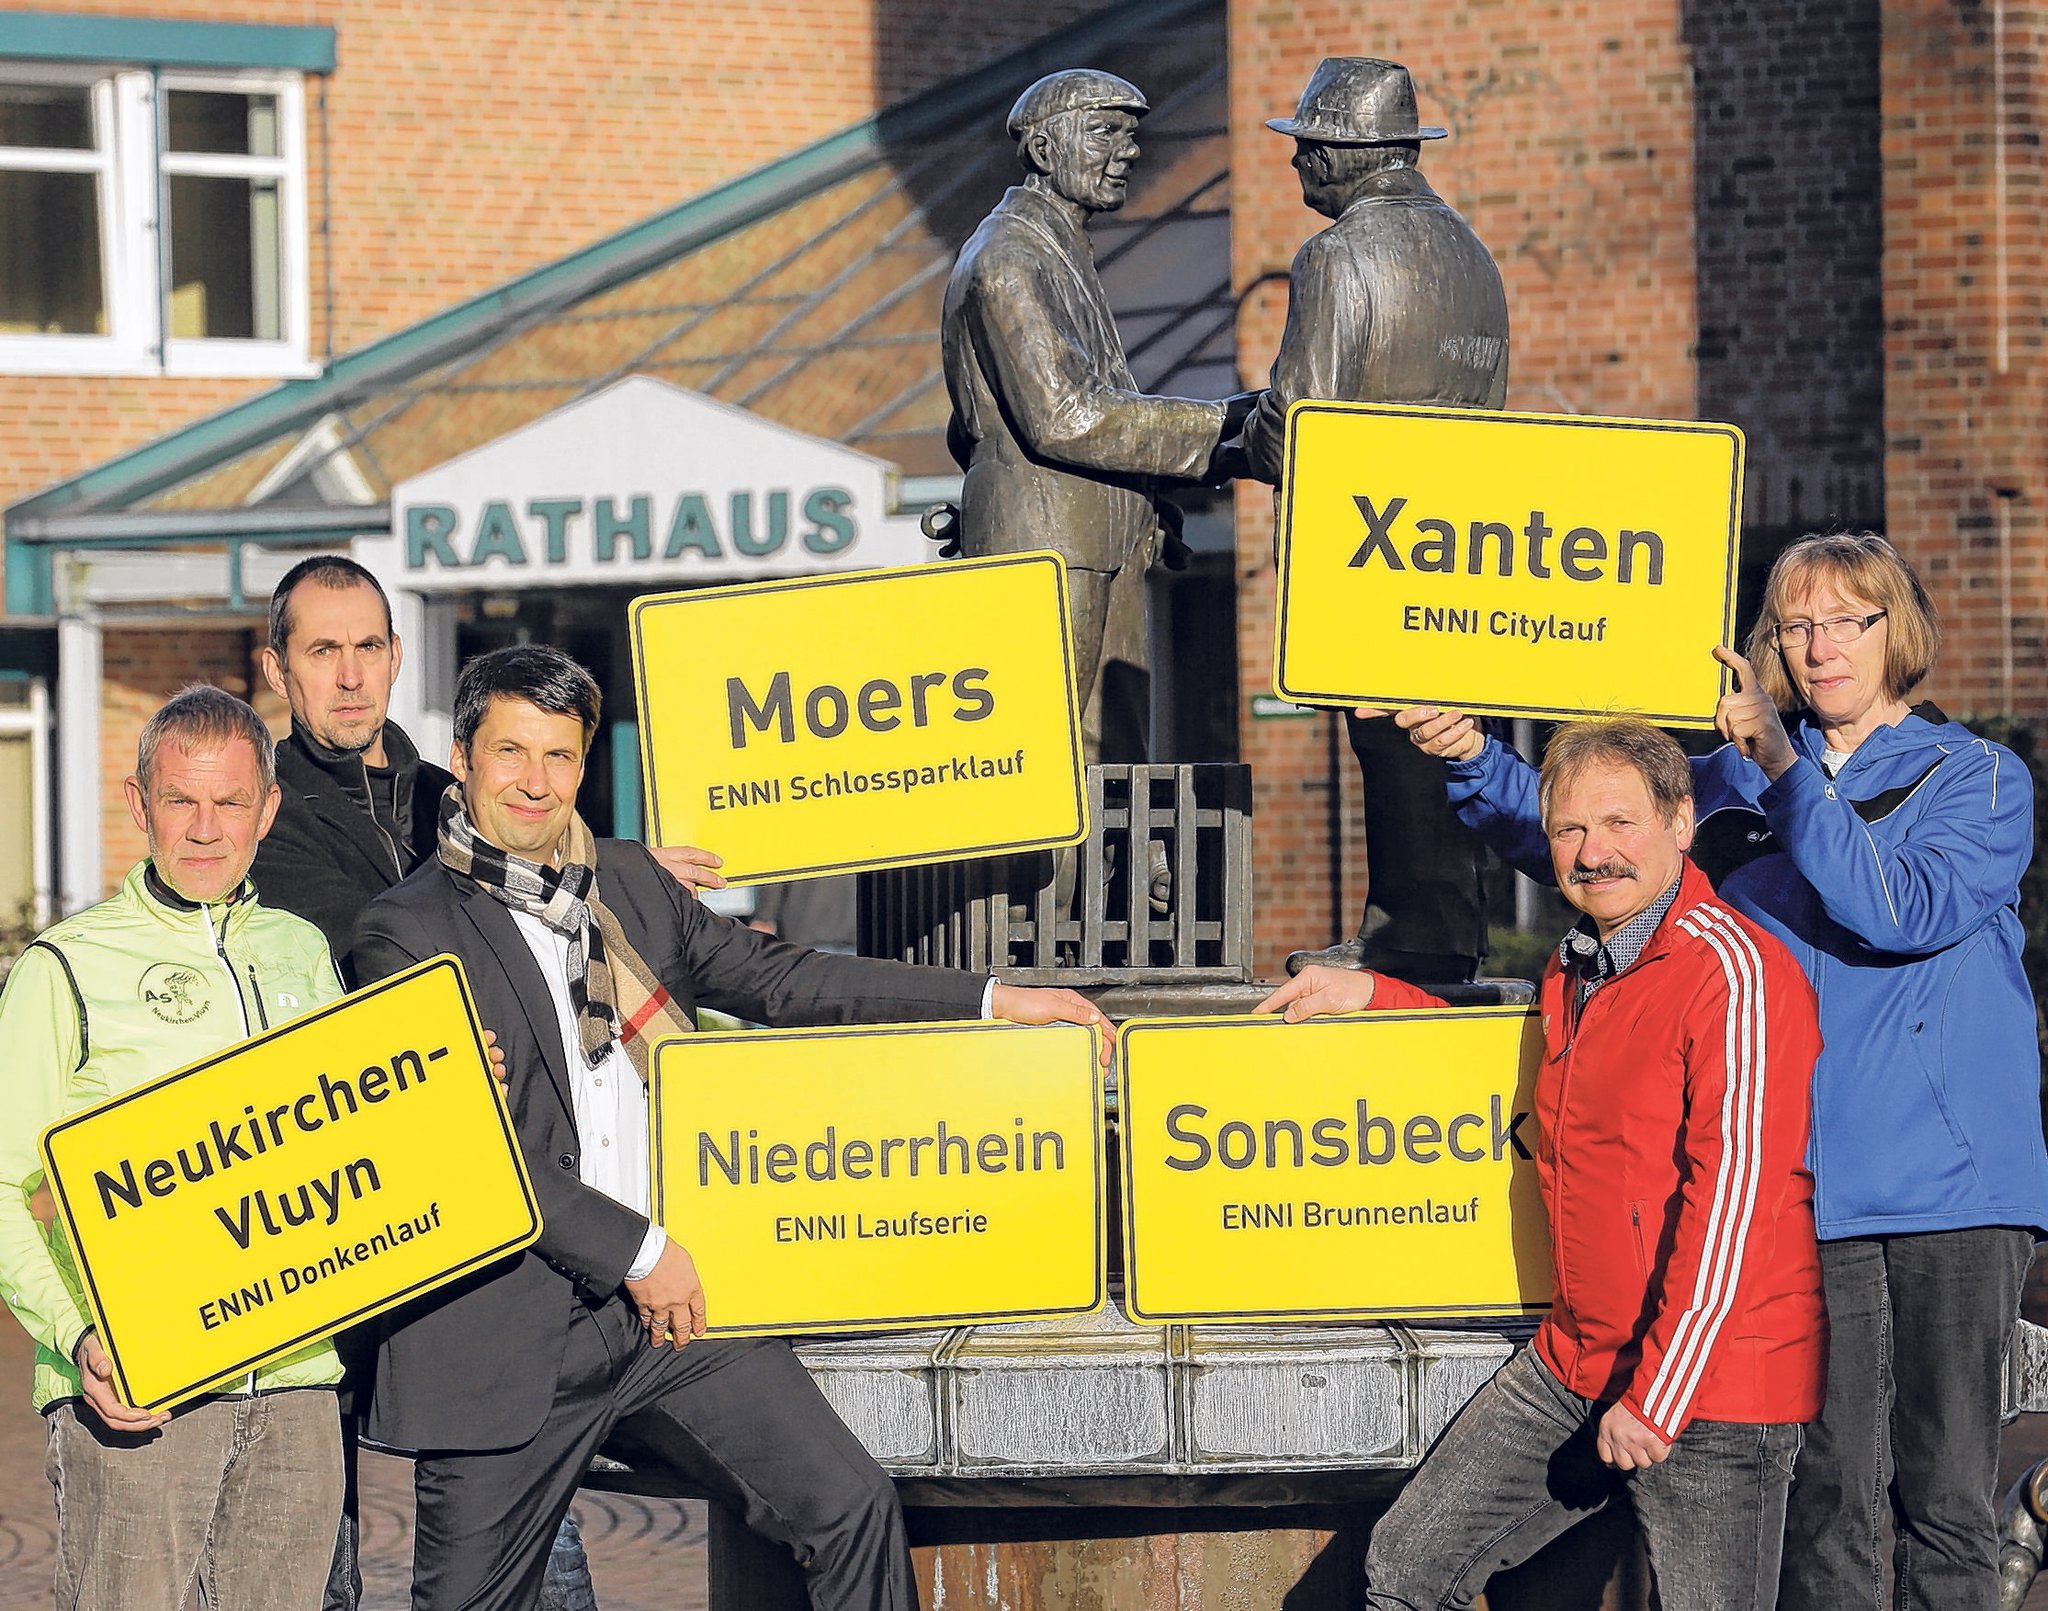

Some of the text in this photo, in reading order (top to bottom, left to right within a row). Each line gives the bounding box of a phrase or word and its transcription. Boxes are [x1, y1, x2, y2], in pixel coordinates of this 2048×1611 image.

[404, 487, 857, 567] RATHAUS
[1347, 494, 1665, 587] Xanten
[1403, 605, 1608, 645] ENNI Citylauf
[726, 667, 996, 750] Moers
[708, 749, 1025, 812] ENNI Schlossparklauf
[151, 999, 211, 1025] Neukirchen-Vluyn
[93, 1045, 450, 1221] Neukirchen-
[698, 1116, 1066, 1188] Niederrhein
[1164, 1094, 1534, 1173] Sonsbeck
[213, 1156, 383, 1251] Vluyn
[776, 1211, 988, 1243] ENNI Laufserie
[1222, 1196, 1479, 1231] ENNI Brunnenlauf
[198, 1202, 442, 1332] ENNI Donkenlauf
